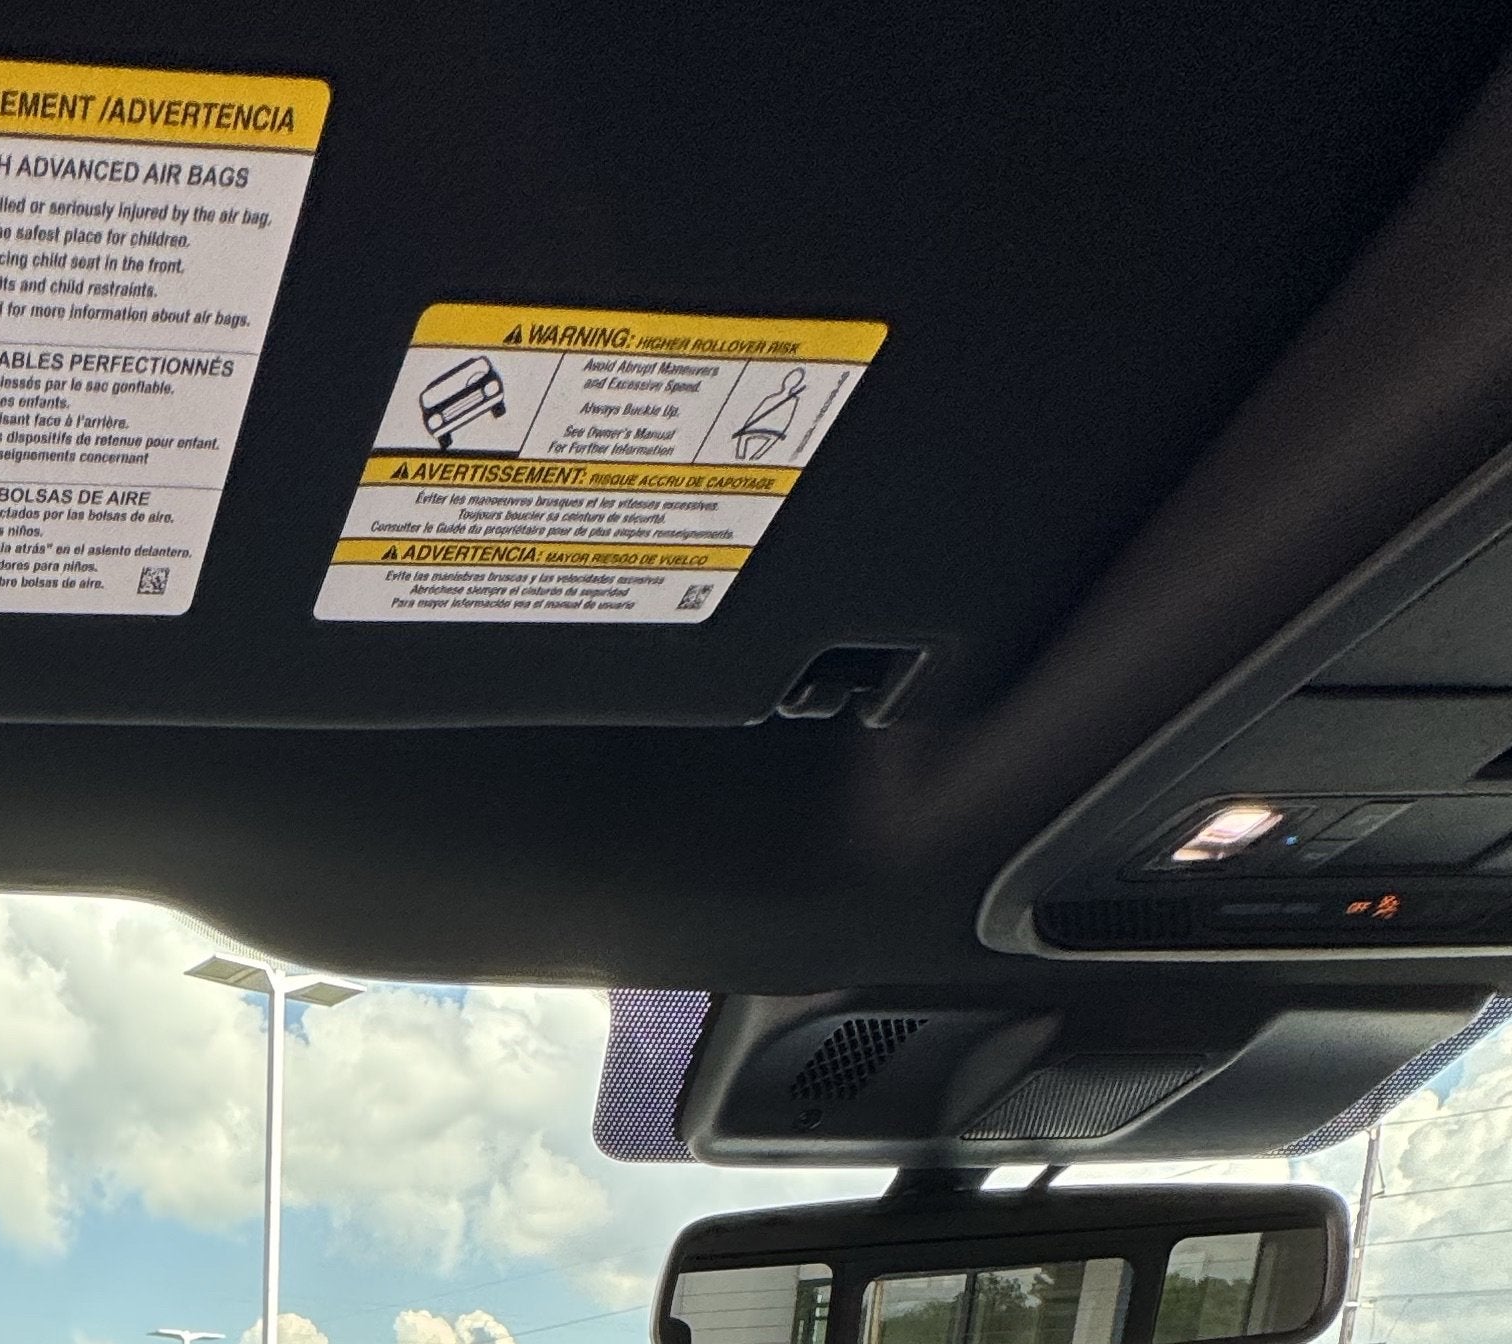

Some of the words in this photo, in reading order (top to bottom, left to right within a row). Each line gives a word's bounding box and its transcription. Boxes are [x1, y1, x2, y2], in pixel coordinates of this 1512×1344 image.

[97, 95, 299, 134] /ADVERTENCIA
[15, 154, 141, 184] ADVANCED
[142, 162, 183, 186] AIR
[186, 164, 251, 188] BAGS
[29, 200, 45, 214] or
[48, 198, 115, 221] seriously
[117, 202, 169, 224] injured
[169, 204, 190, 225] by
[192, 206, 216, 222] the
[218, 207, 240, 224] air
[240, 208, 274, 229] bag.
[15, 223, 60, 243] safest
[63, 227, 103, 247] place
[106, 228, 127, 245] for
[129, 230, 192, 250] children.
[19, 276, 47, 293] and
[49, 278, 84, 295] child
[87, 279, 159, 298] restraints.
[523, 323, 639, 349] WARNING:
[69, 350, 236, 377] PERFECTIONNÉS
[409, 462, 590, 485] AVERTISSEMENT:
[77, 489, 103, 504] DE
[106, 490, 151, 506] AIRE
[399, 544, 545, 562] ADVERTENCIA:
